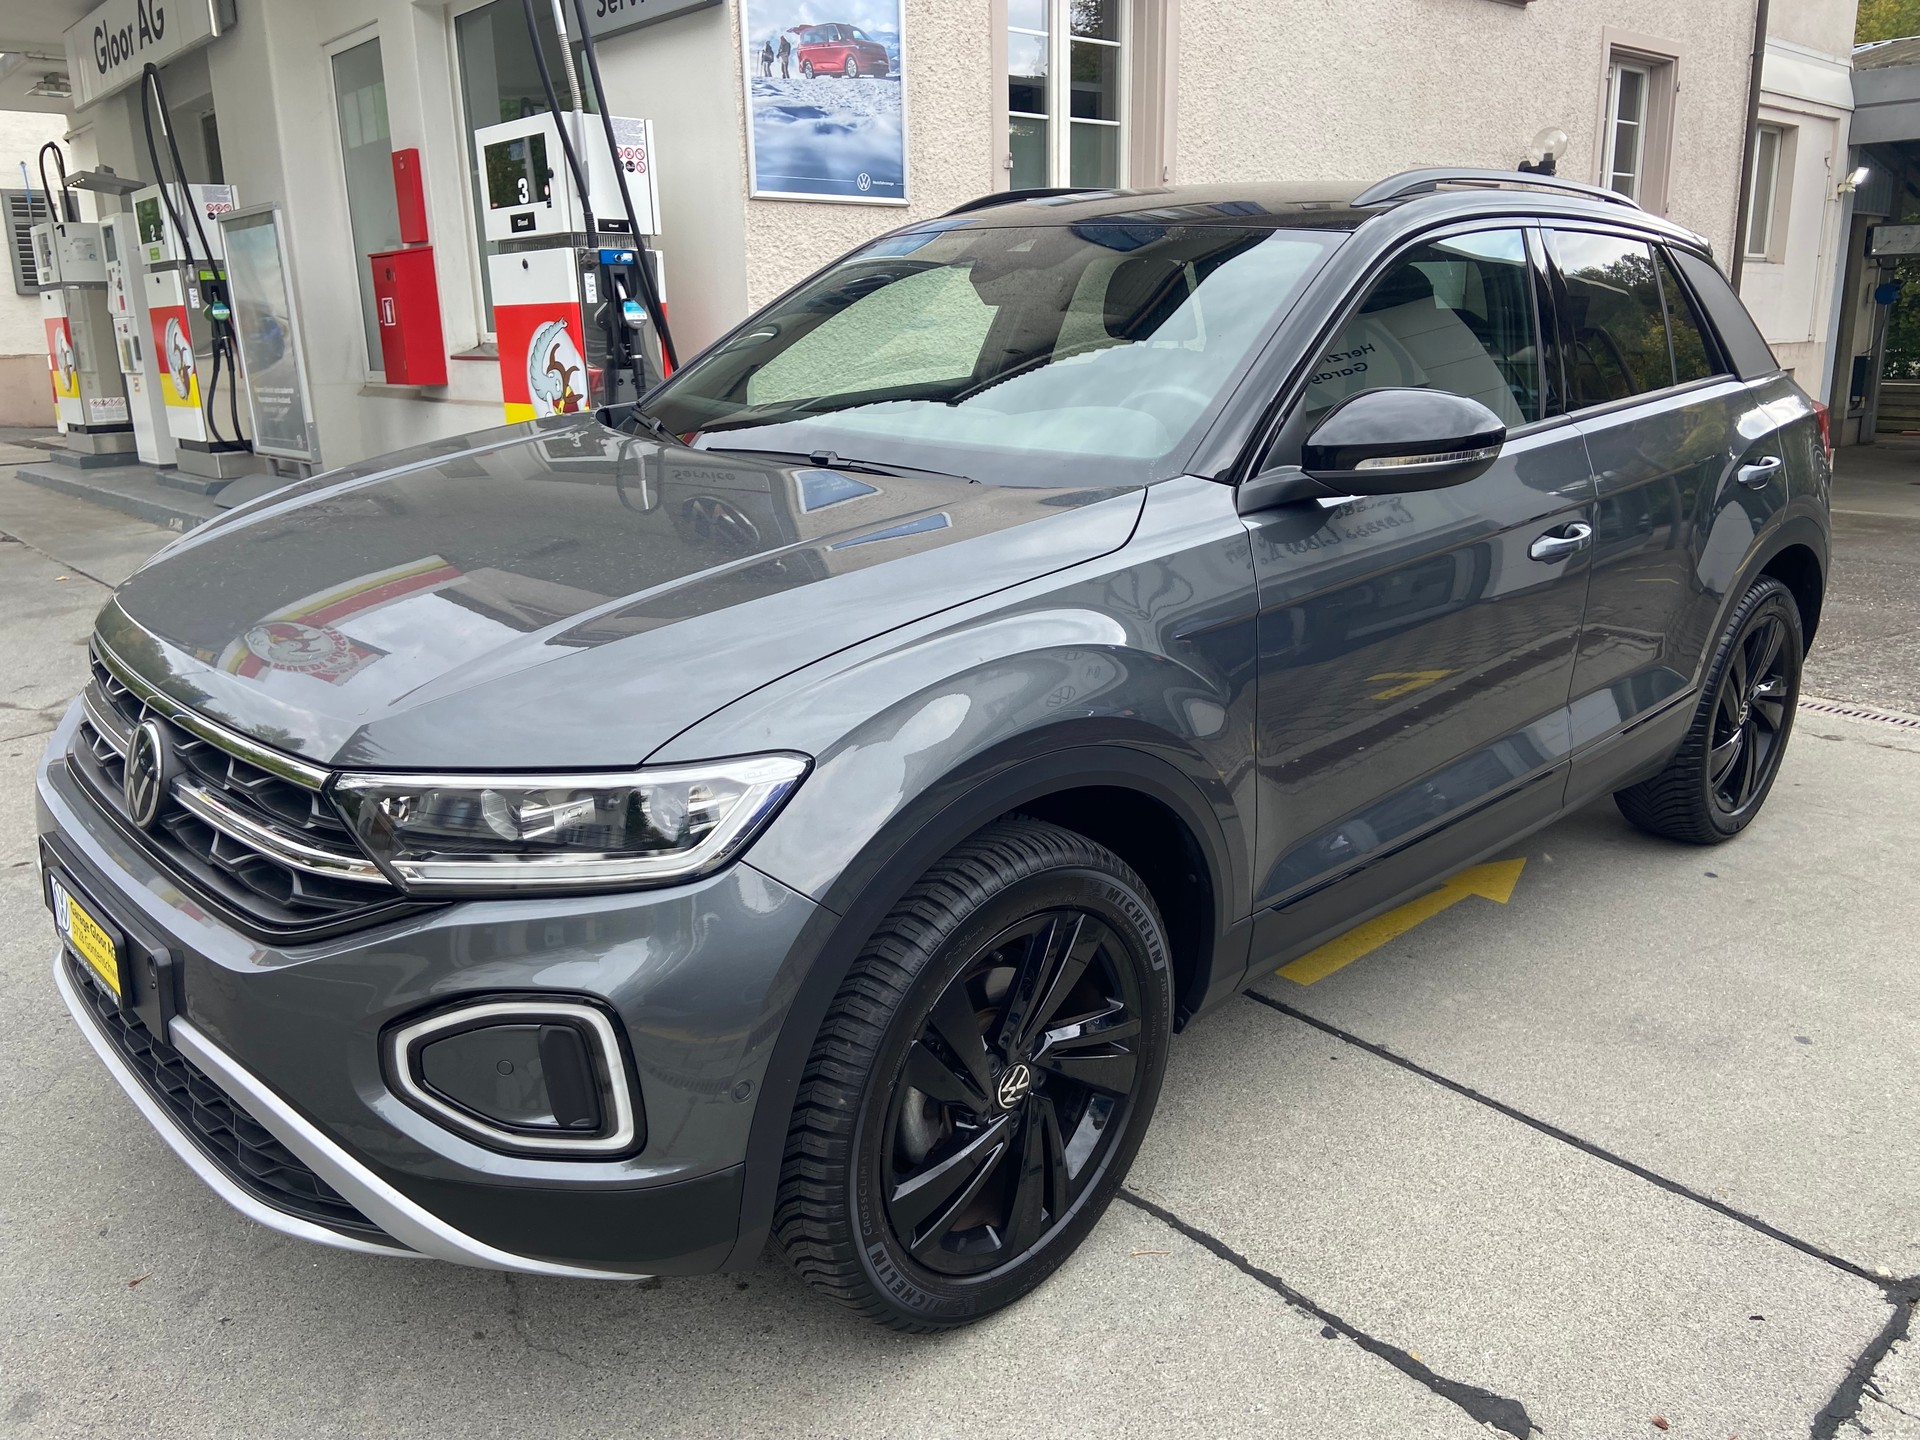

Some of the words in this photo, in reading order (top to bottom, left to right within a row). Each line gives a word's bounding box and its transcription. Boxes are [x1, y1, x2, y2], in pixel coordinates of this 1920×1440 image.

[93, 19, 134, 75] Gloor
[137, 0, 165, 50] AG
[517, 177, 530, 204] 3
[55, 224, 67, 237] 1
[149, 225, 157, 242] 2
[1105, 887, 1164, 965] MICHELIN
